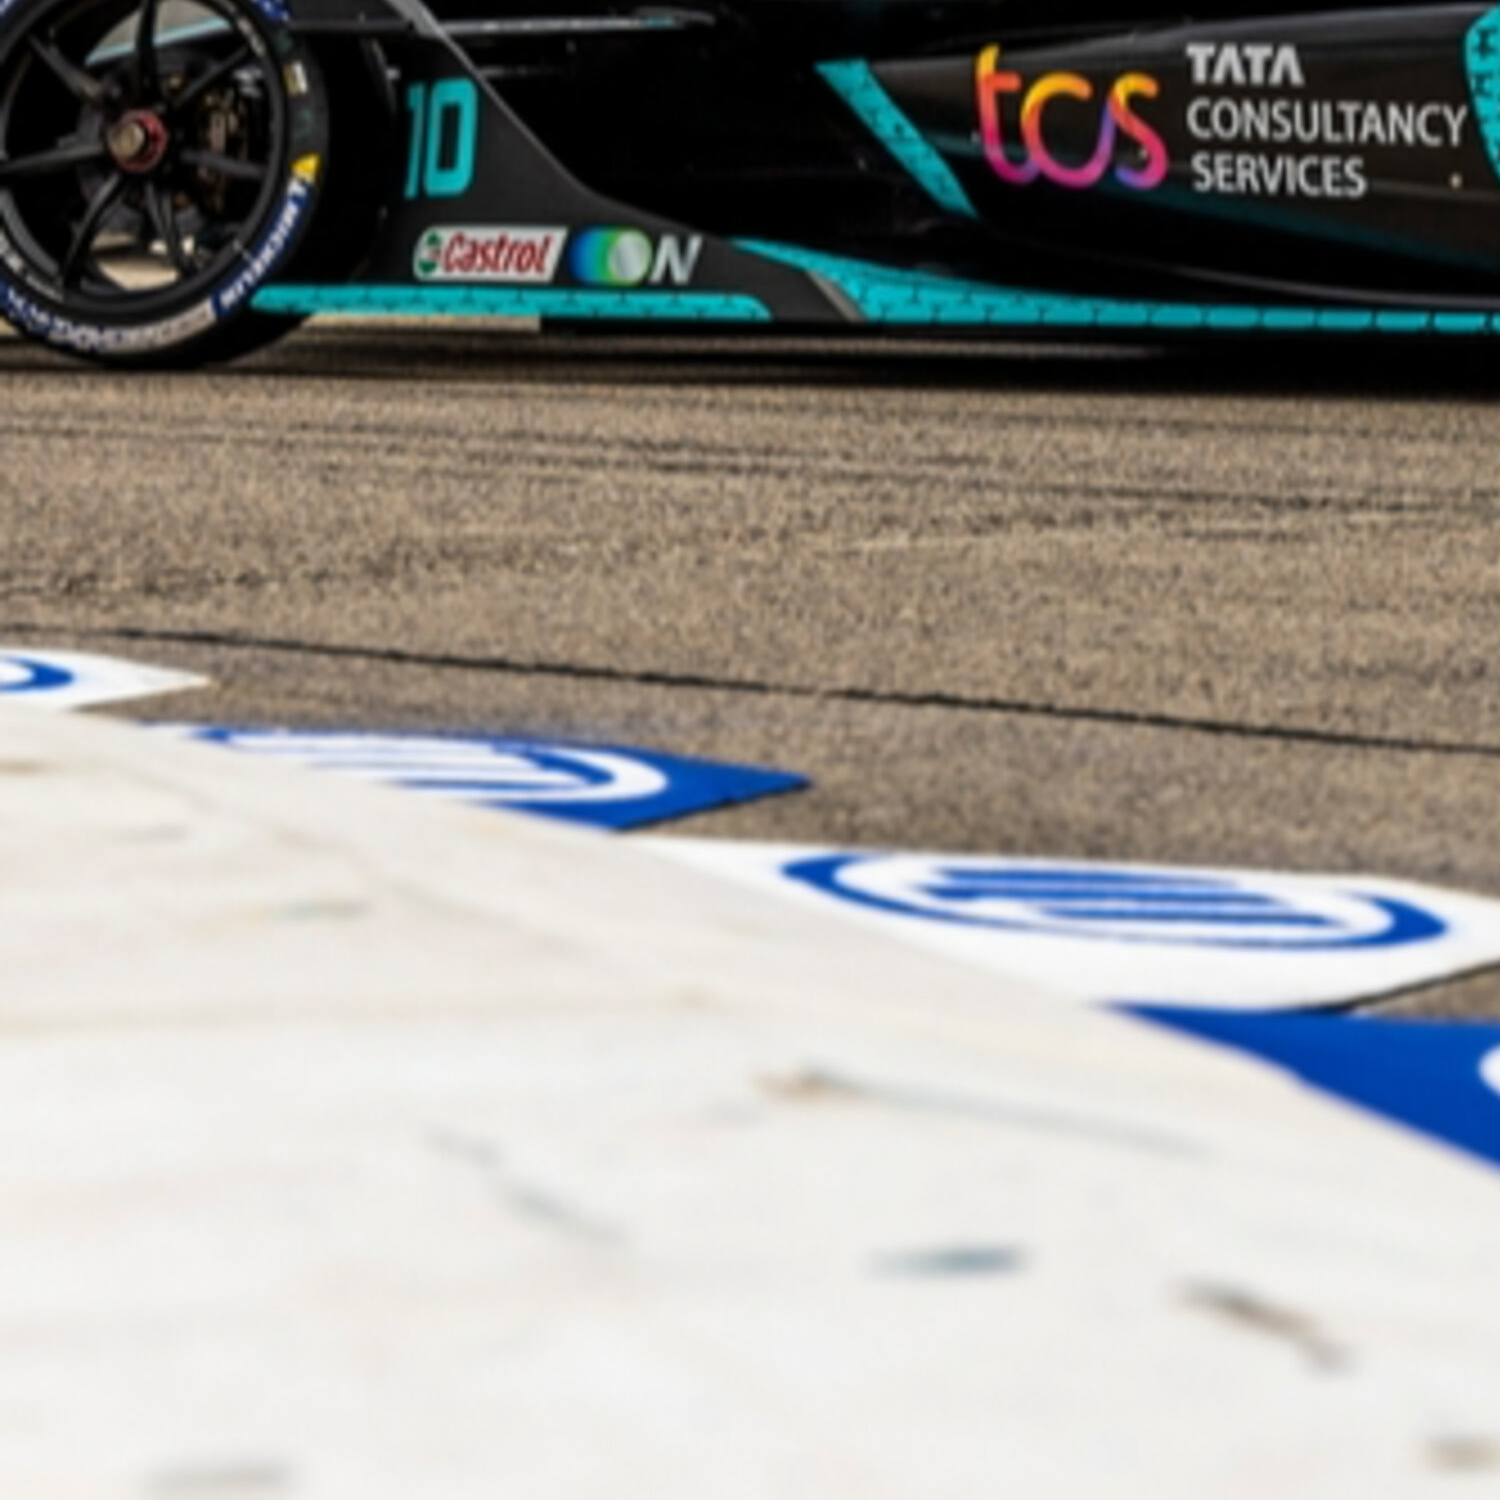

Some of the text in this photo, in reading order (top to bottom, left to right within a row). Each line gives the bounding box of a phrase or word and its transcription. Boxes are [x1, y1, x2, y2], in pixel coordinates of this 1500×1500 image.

[1185, 44, 1305, 86] TATA
[403, 78, 478, 199] 10
[1186, 98, 1467, 146] CONSULTANCY
[1190, 153, 1368, 197] SERVICES
[442, 231, 555, 274] Castrol
